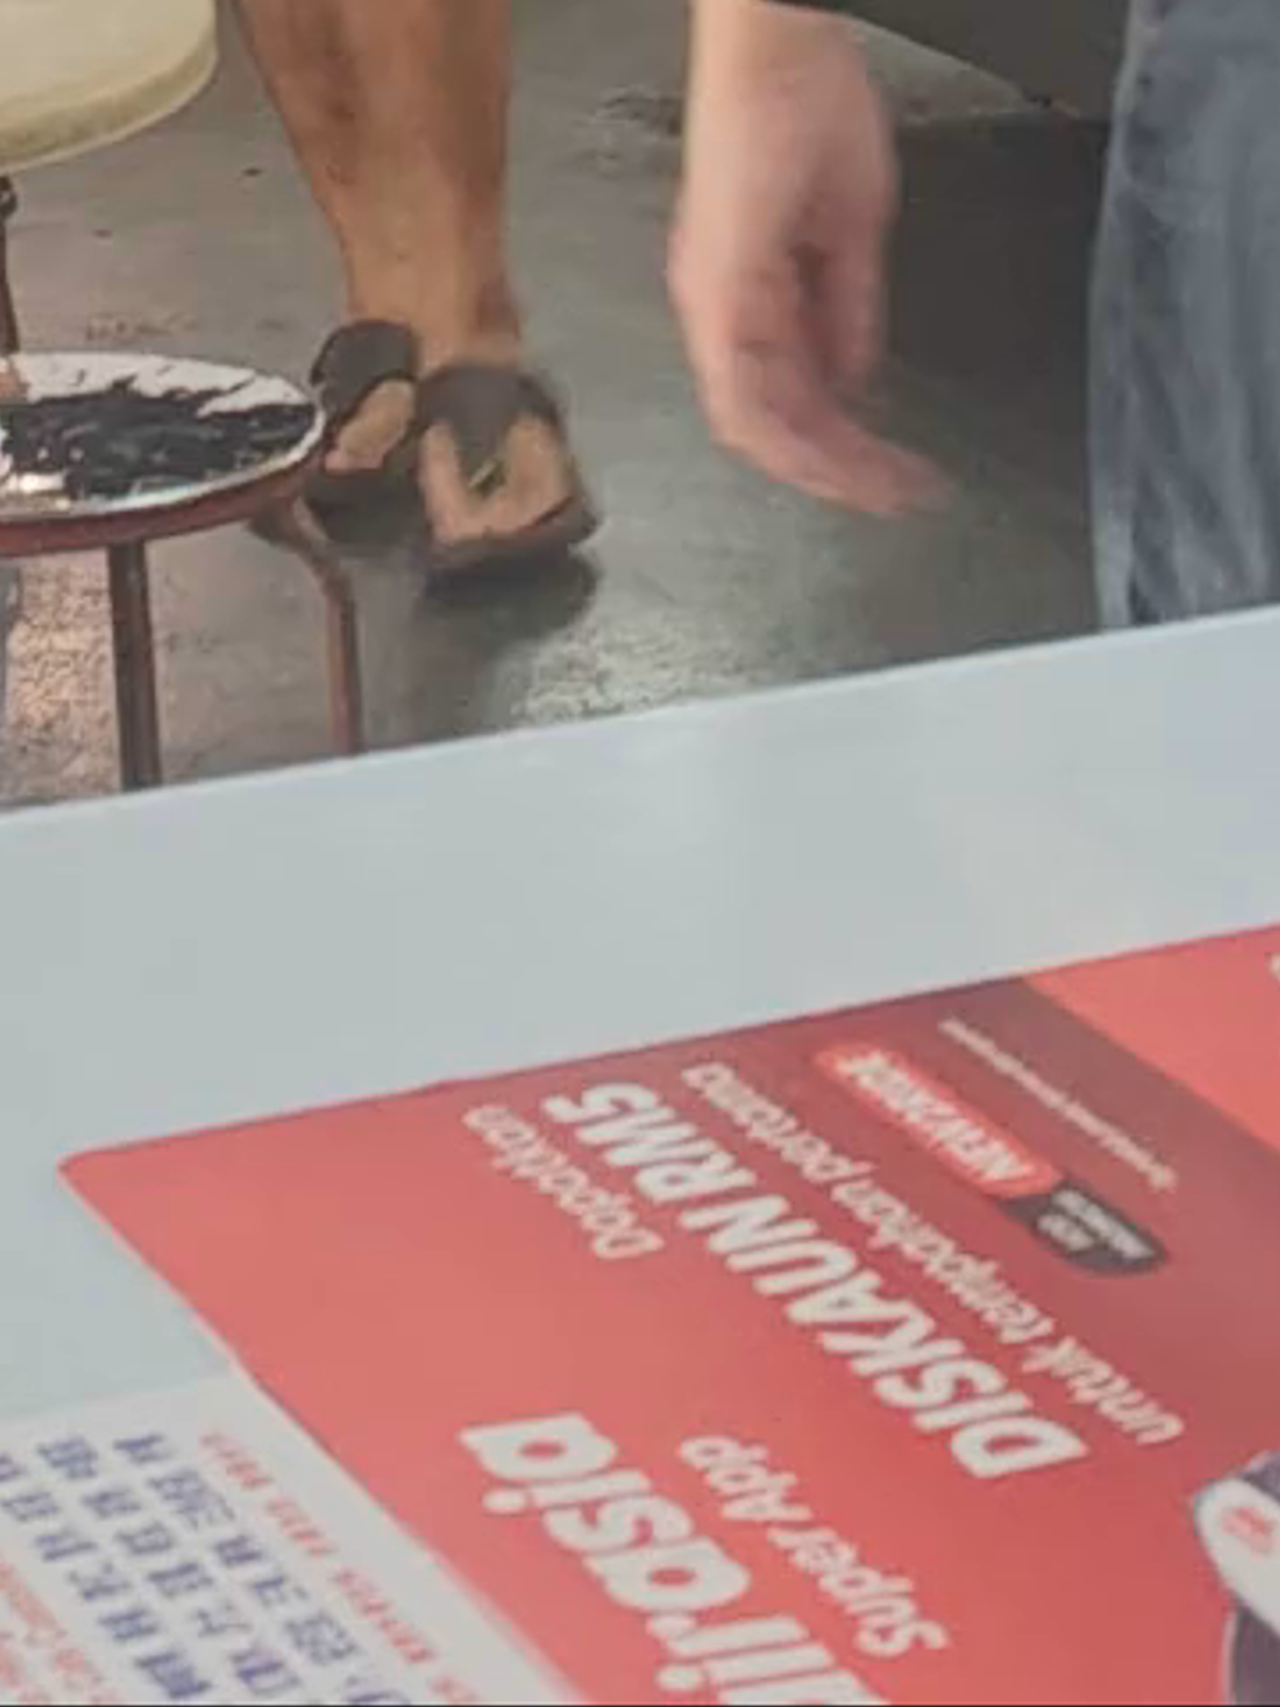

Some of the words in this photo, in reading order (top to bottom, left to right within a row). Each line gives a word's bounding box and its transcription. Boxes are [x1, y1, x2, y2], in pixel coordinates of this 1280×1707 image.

[461, 1101, 665, 1263] Dapatkan
[541, 1082, 756, 1206] RM5
[681, 1061, 876, 1185] pertama
[828, 1179, 1055, 1347] tempahan
[678, 1193, 1091, 1480] DISKAUN
[1020, 1335, 1187, 1447] untuk
[678, 1434, 814, 1523] App
[766, 1524, 953, 1660] Super
